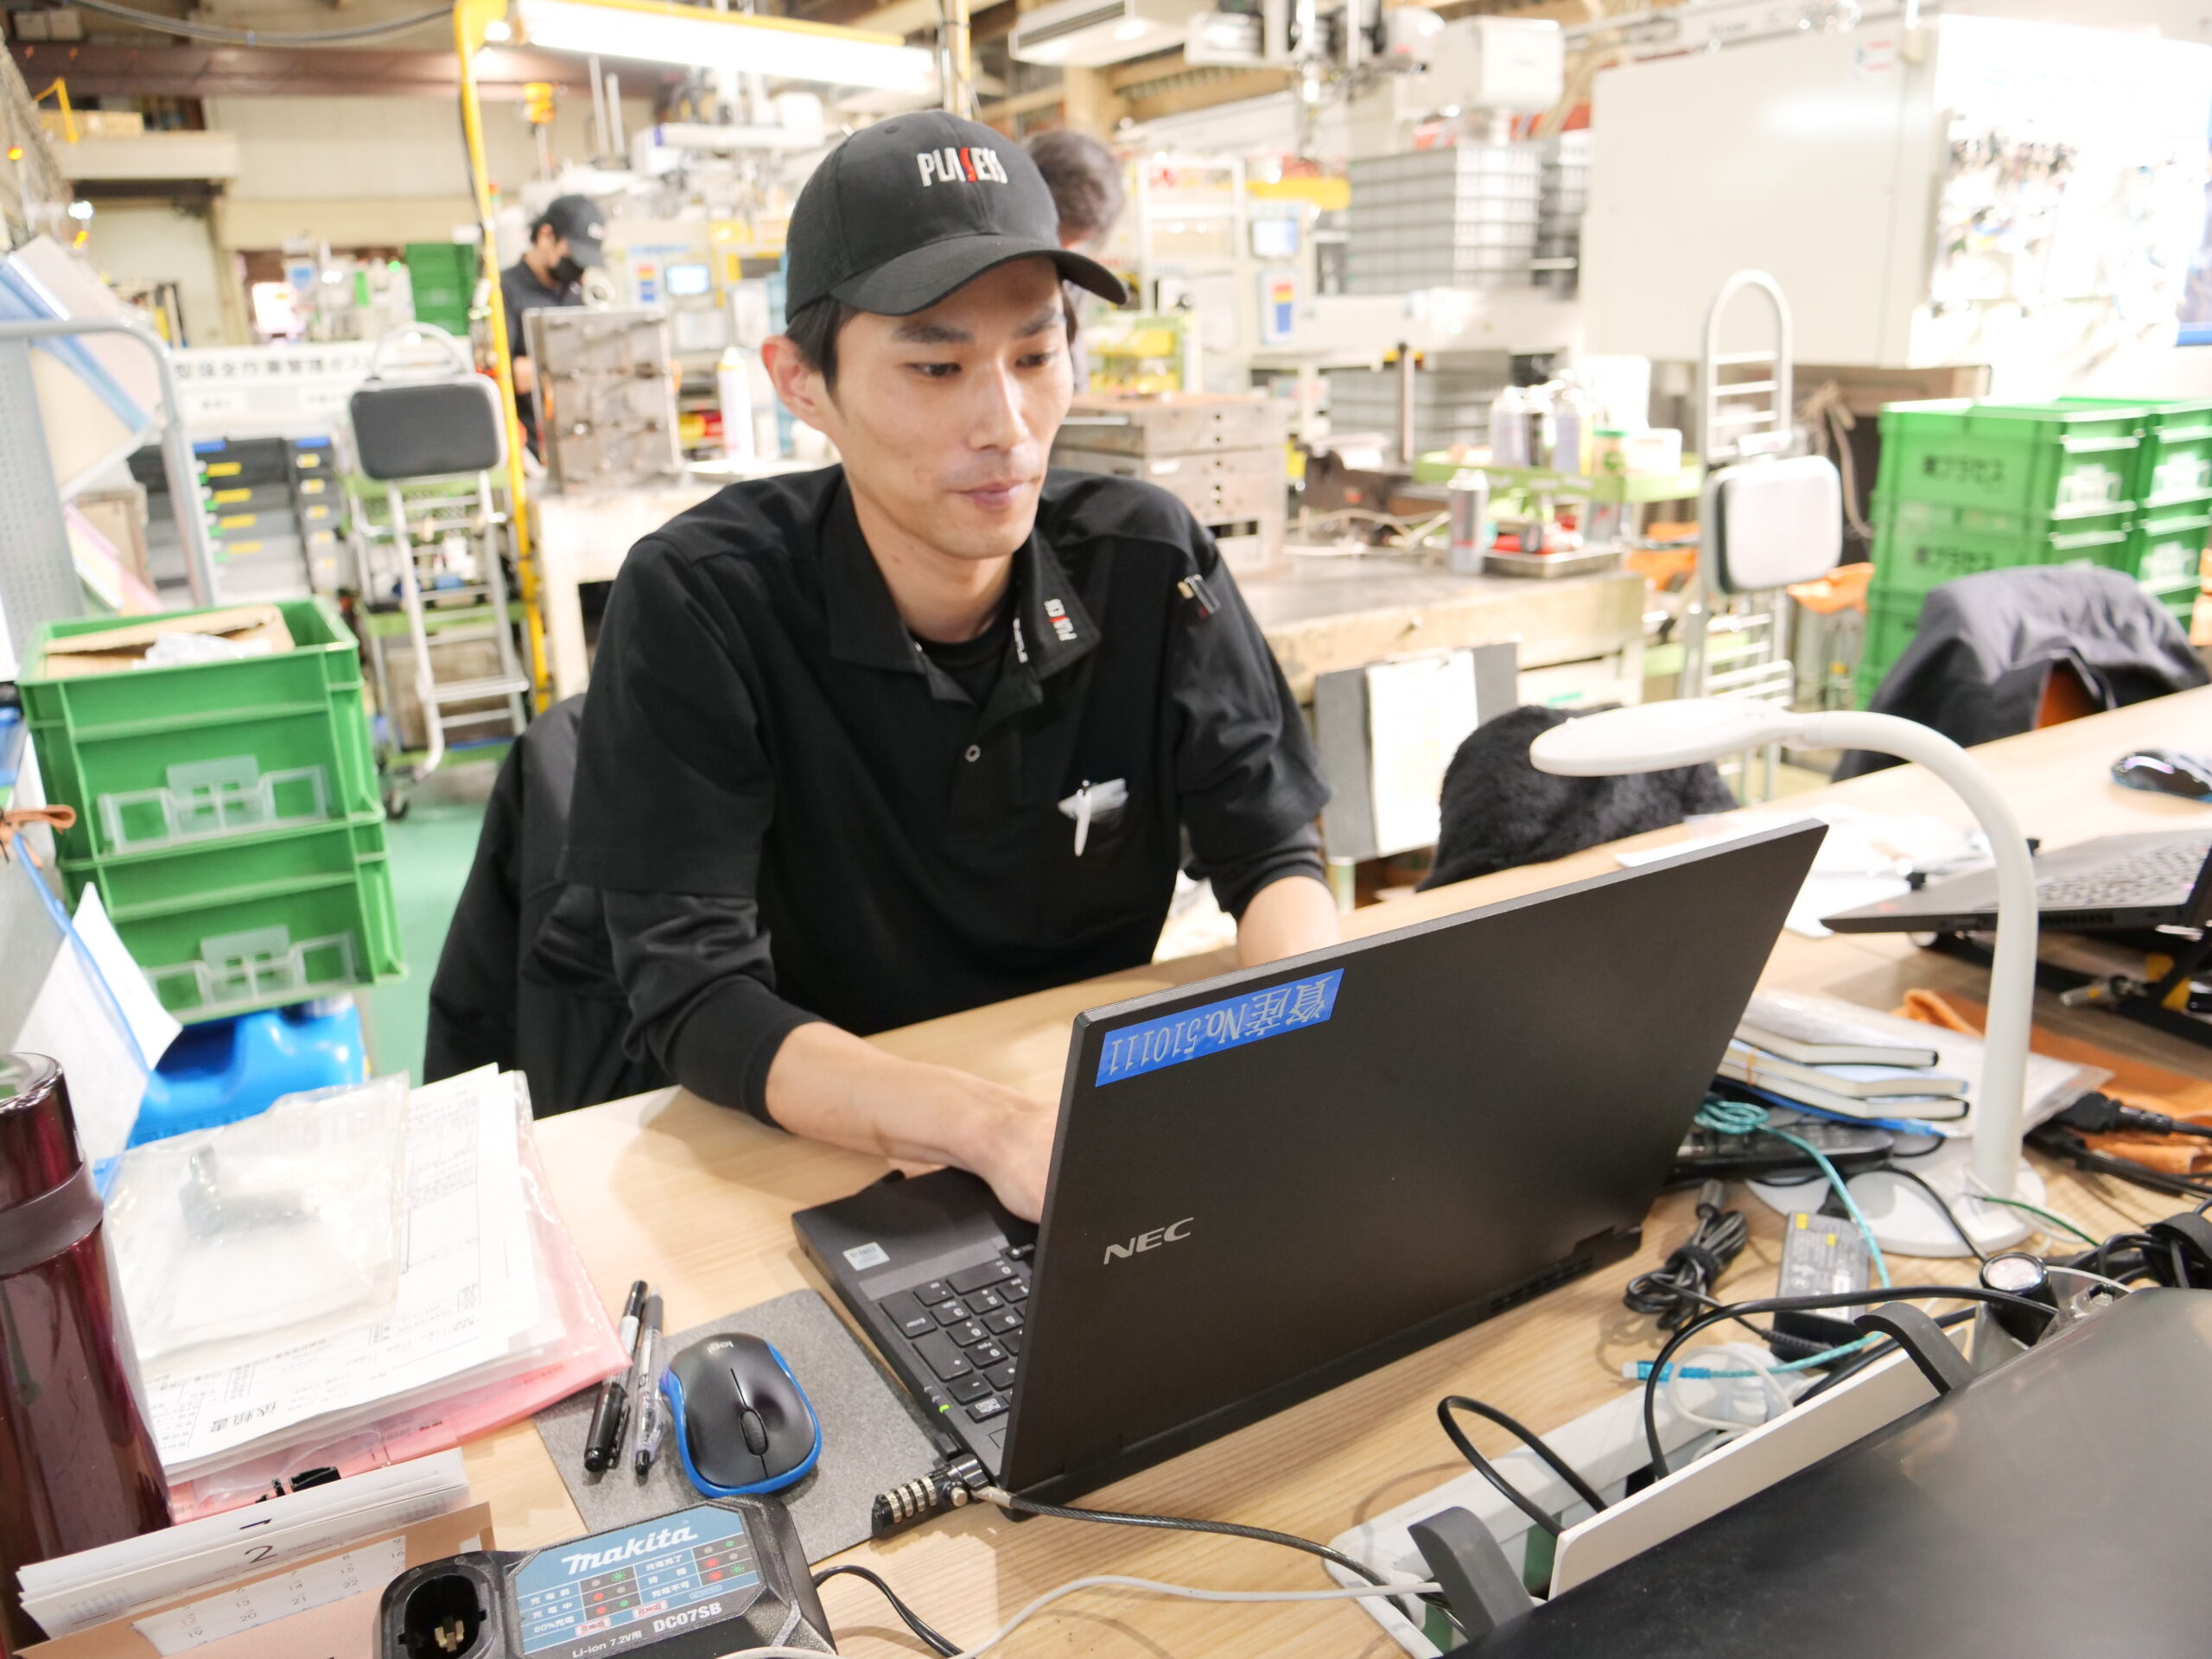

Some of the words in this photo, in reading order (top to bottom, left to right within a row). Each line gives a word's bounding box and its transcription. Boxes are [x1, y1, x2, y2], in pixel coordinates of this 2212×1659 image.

[1103, 1217, 1194, 1265] NEC
[244, 1545, 277, 1565] 2
[342, 1579, 359, 1589] 22
[652, 1602, 723, 1633] DC07SB
[571, 1642, 607, 1658] Li-ion
